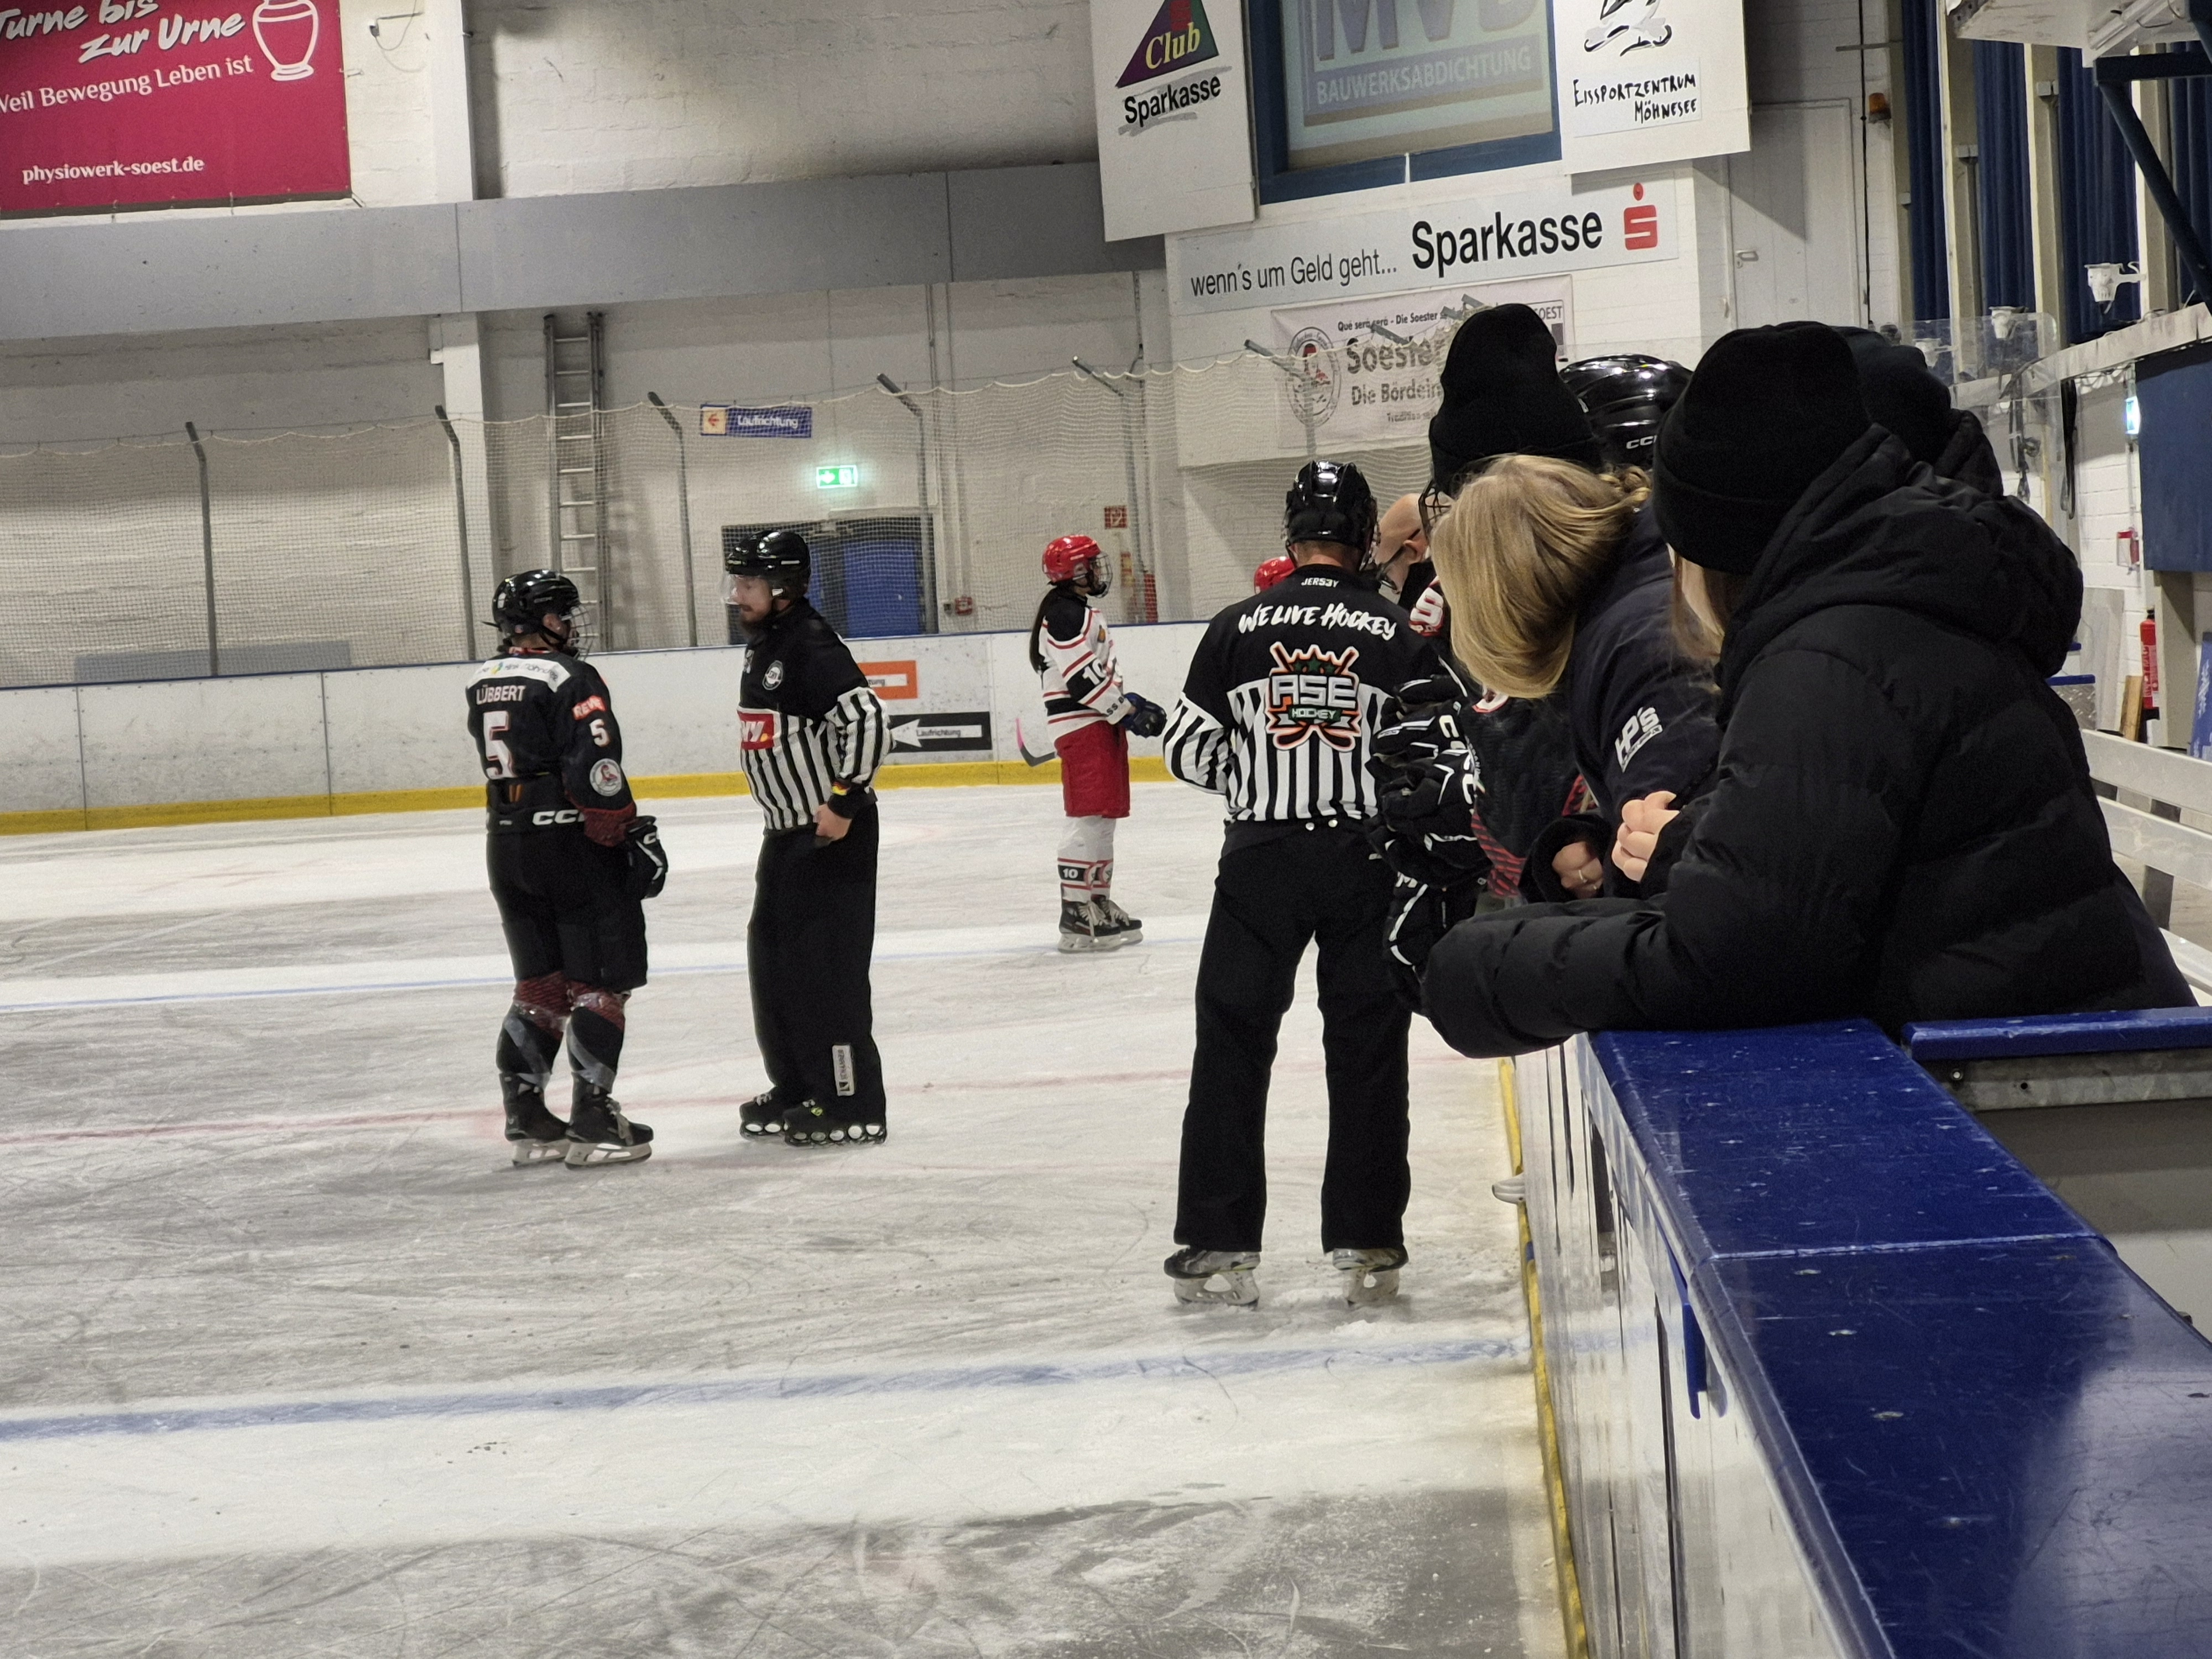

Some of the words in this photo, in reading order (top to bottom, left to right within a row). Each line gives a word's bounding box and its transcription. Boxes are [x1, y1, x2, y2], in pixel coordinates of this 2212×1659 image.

[0, 6, 88, 40] Turne
[99, 0, 159, 24] bis
[78, 28, 150, 64] zur
[158, 13, 246, 51] Urne
[1146, 22, 1201, 70] Club
[39, 75, 152, 107] Bewegung
[155, 62, 221, 88] Leben
[225, 55, 254, 77] ist
[1317, 45, 1531, 105] BAUWERKSABDICHTUNG
[1124, 76, 1221, 127] Sparkasse
[1635, 98, 1697, 124] MÖHNESEE
[23, 156, 204, 185] physiowerk-soest.de
[1258, 266, 1285, 288] um
[1291, 254, 1333, 284] Geld
[1412, 211, 1603, 278] Sparkasse
[1396, 314, 1408, 325] Die
[1410, 312, 1438, 324] Soester
[1352, 385, 1376, 405] Die
[737, 415, 799, 429] Laufrichtung
[1271, 606, 1321, 625] LIVE
[476, 684, 526, 705] LÜBBERT
[1272, 674, 1357, 709] ASE
[1292, 707, 1338, 719] HOCKEY
[483, 710, 518, 780] 5
[589, 719, 609, 747] 5
[916, 729, 961, 738] Laufrichtung
[1063, 869, 1078, 878] 10
